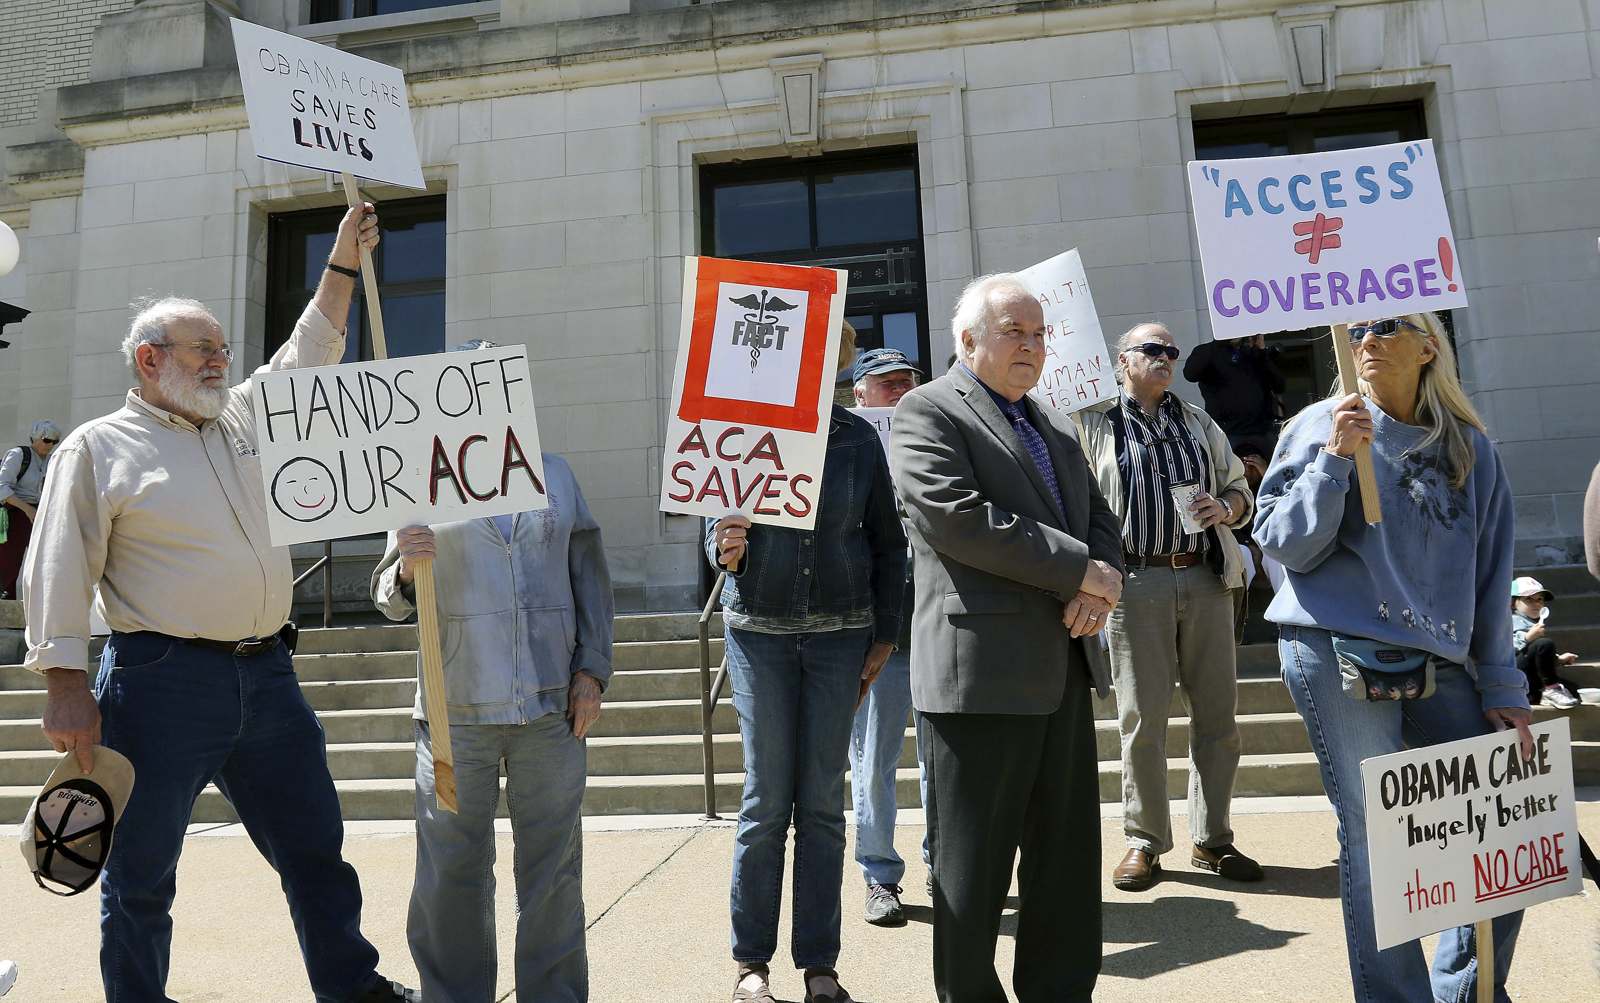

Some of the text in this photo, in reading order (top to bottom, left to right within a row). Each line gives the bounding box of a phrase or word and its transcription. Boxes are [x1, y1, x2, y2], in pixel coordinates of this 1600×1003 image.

[291, 89, 377, 130] SAVES
[292, 116, 374, 162] LIVES
[1039, 279, 1089, 306] ALTH
[1213, 236, 1458, 318] COVERAGE!
[731, 320, 790, 351] FACT
[1046, 318, 1075, 343] RE
[1036, 355, 1102, 394] UMAN
[1045, 379, 1100, 410] IGHT
[261, 355, 524, 442] HANDS OFF
[677, 424, 784, 471] ACA
[271, 425, 545, 523] OUR ACA
[668, 460, 813, 518] SAVES
[1380, 753, 1481, 811] OBAMA
[1496, 793, 1559, 828] better
[1404, 832, 1569, 914] than NO CARE
